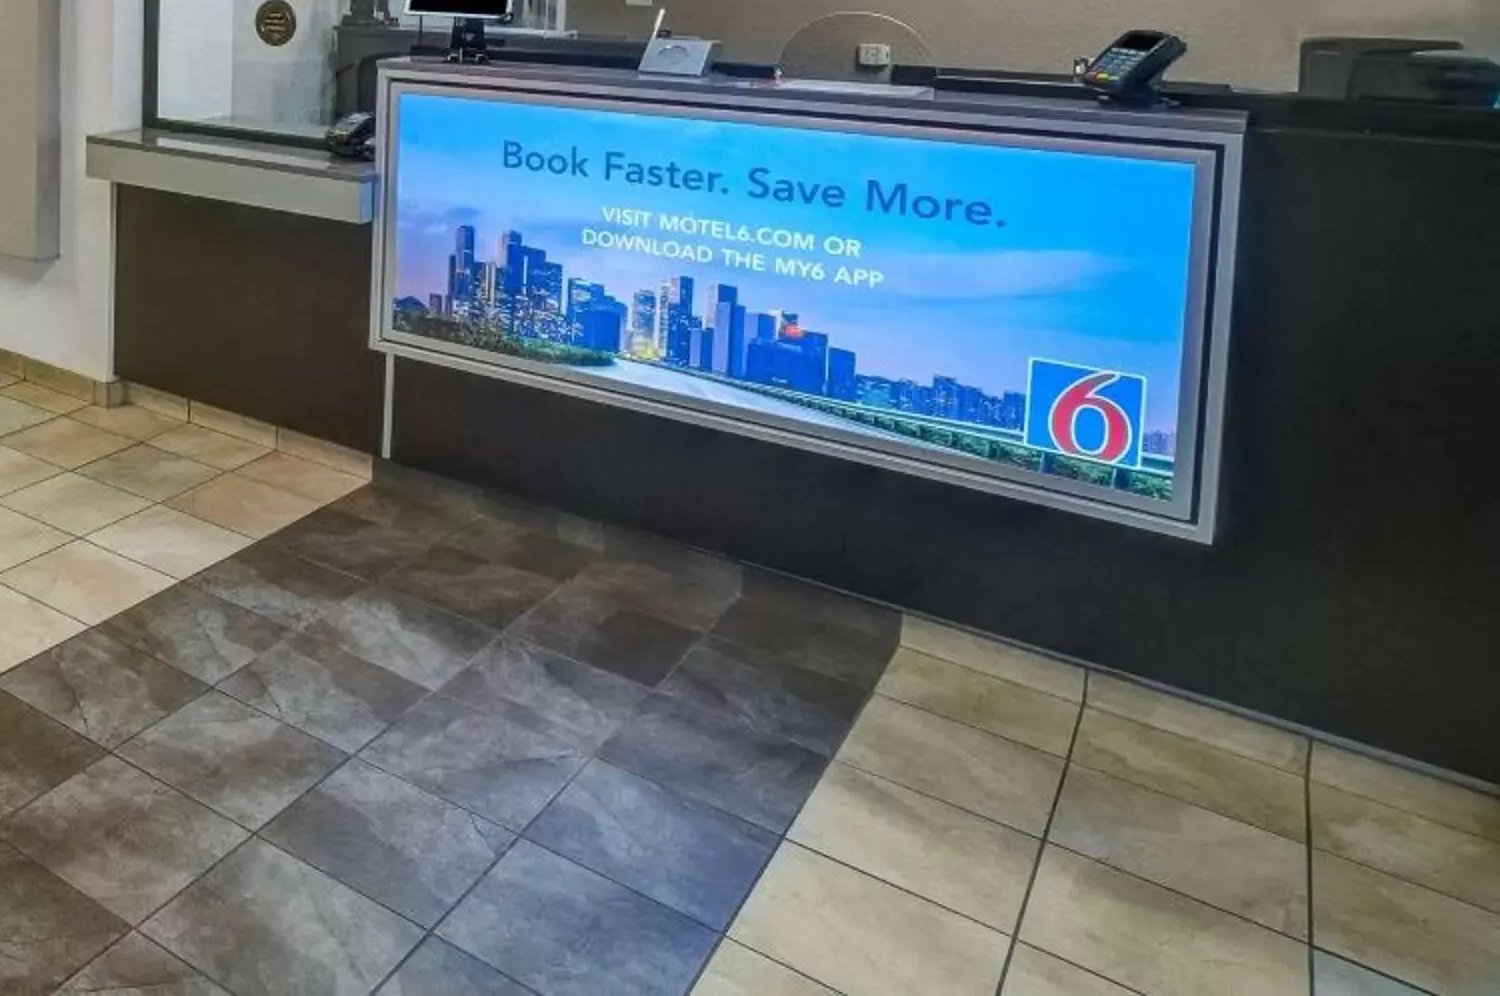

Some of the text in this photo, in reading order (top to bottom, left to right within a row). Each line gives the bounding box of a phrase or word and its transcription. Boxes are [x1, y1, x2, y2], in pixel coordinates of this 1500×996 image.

[502, 139, 1007, 228] Book Faster. Save More.
[581, 228, 885, 290] DOWNLOAD THE MY6 APP
[601, 205, 862, 258] VISIT MOTEL6.COM OR
[1047, 369, 1133, 464] 6
